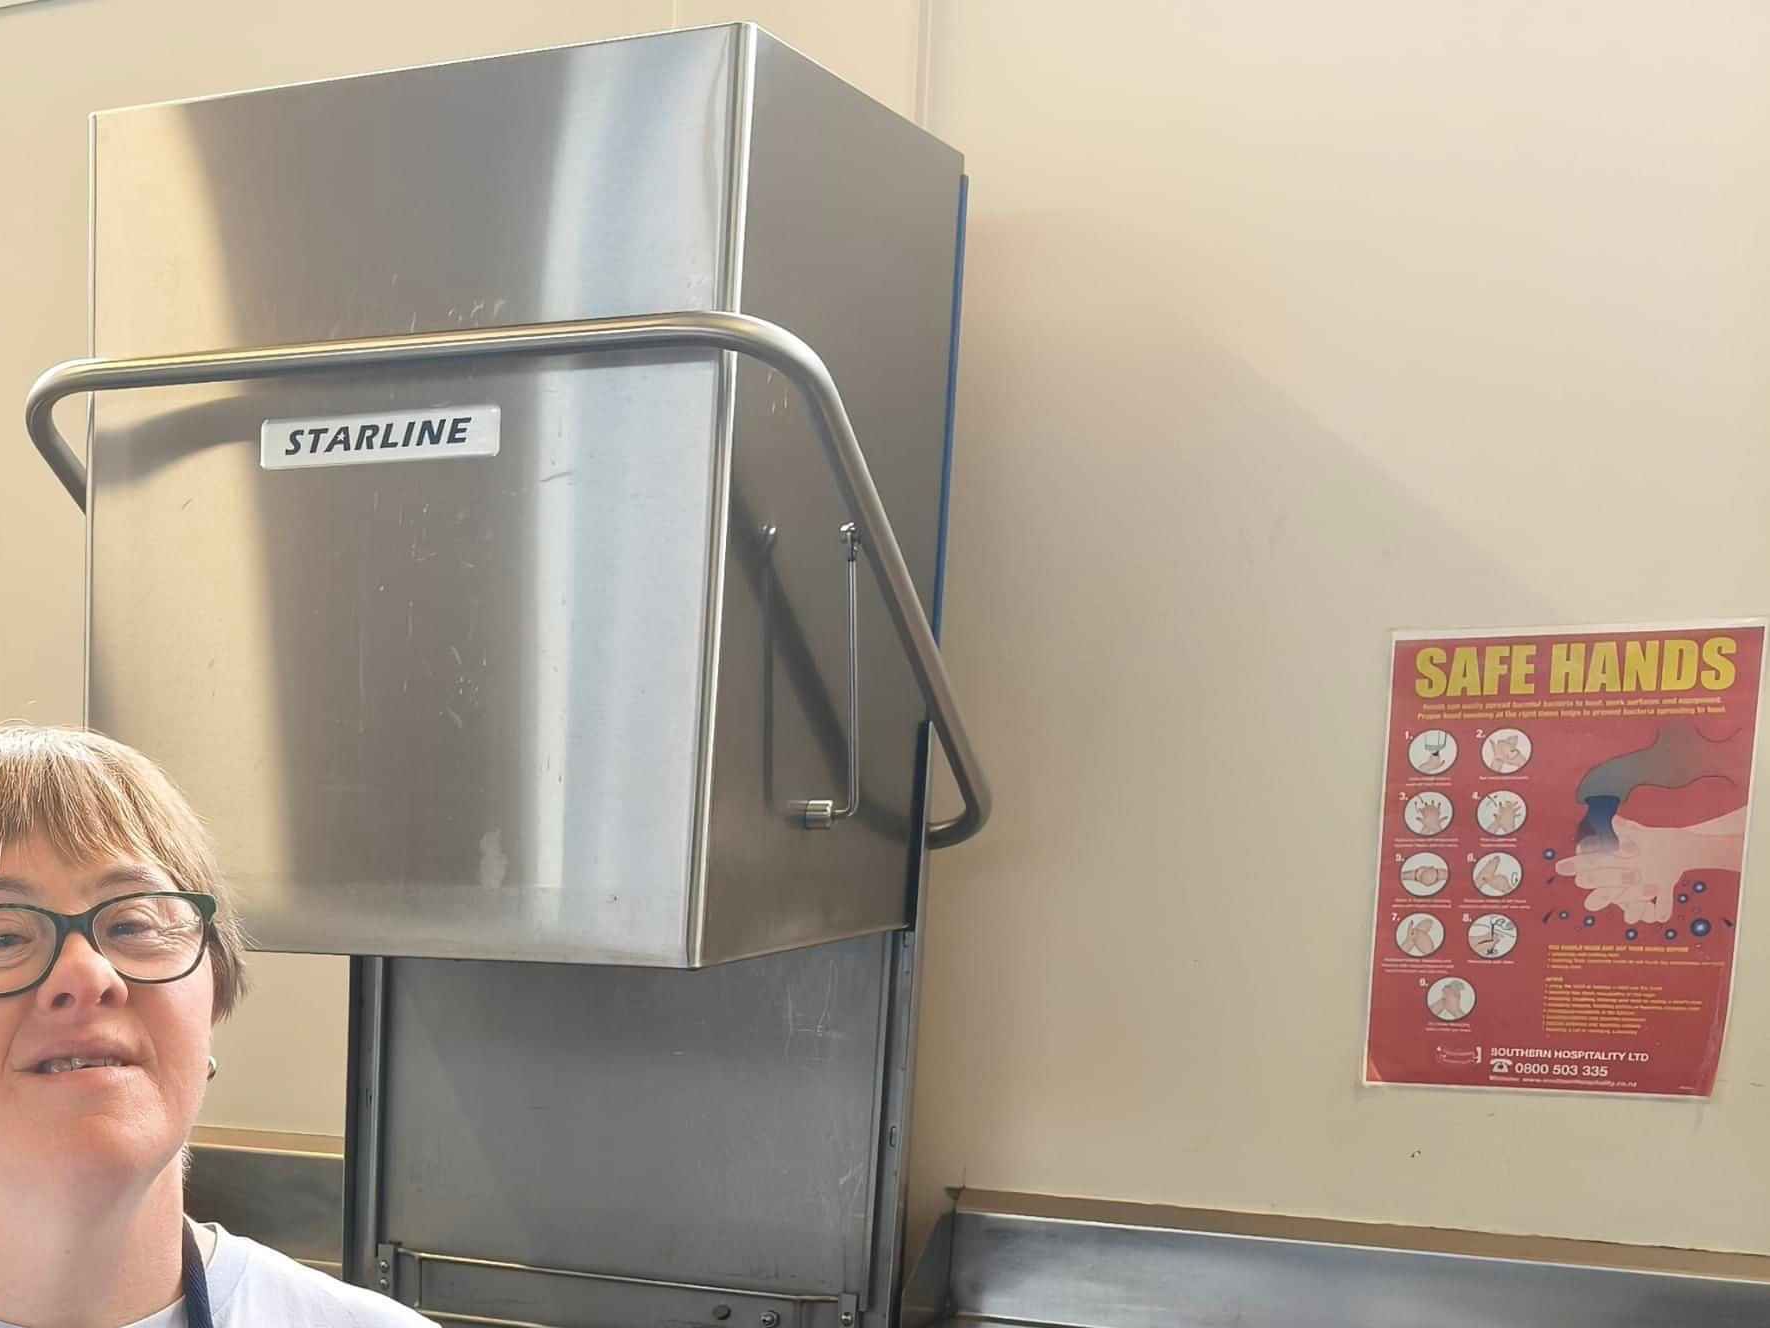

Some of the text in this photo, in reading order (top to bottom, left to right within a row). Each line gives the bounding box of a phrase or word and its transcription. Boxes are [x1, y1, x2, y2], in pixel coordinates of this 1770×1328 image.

[285, 416, 472, 456] STARLINE
[1415, 637, 1737, 698] SAFE HANDS
[1405, 731, 1414, 740] 1.
[1475, 729, 1486, 739] 2.
[1490, 1047, 1649, 1063] SOUTHERN HOSPITALITY LTD
[1514, 1063, 1609, 1077] 0800 503 335
